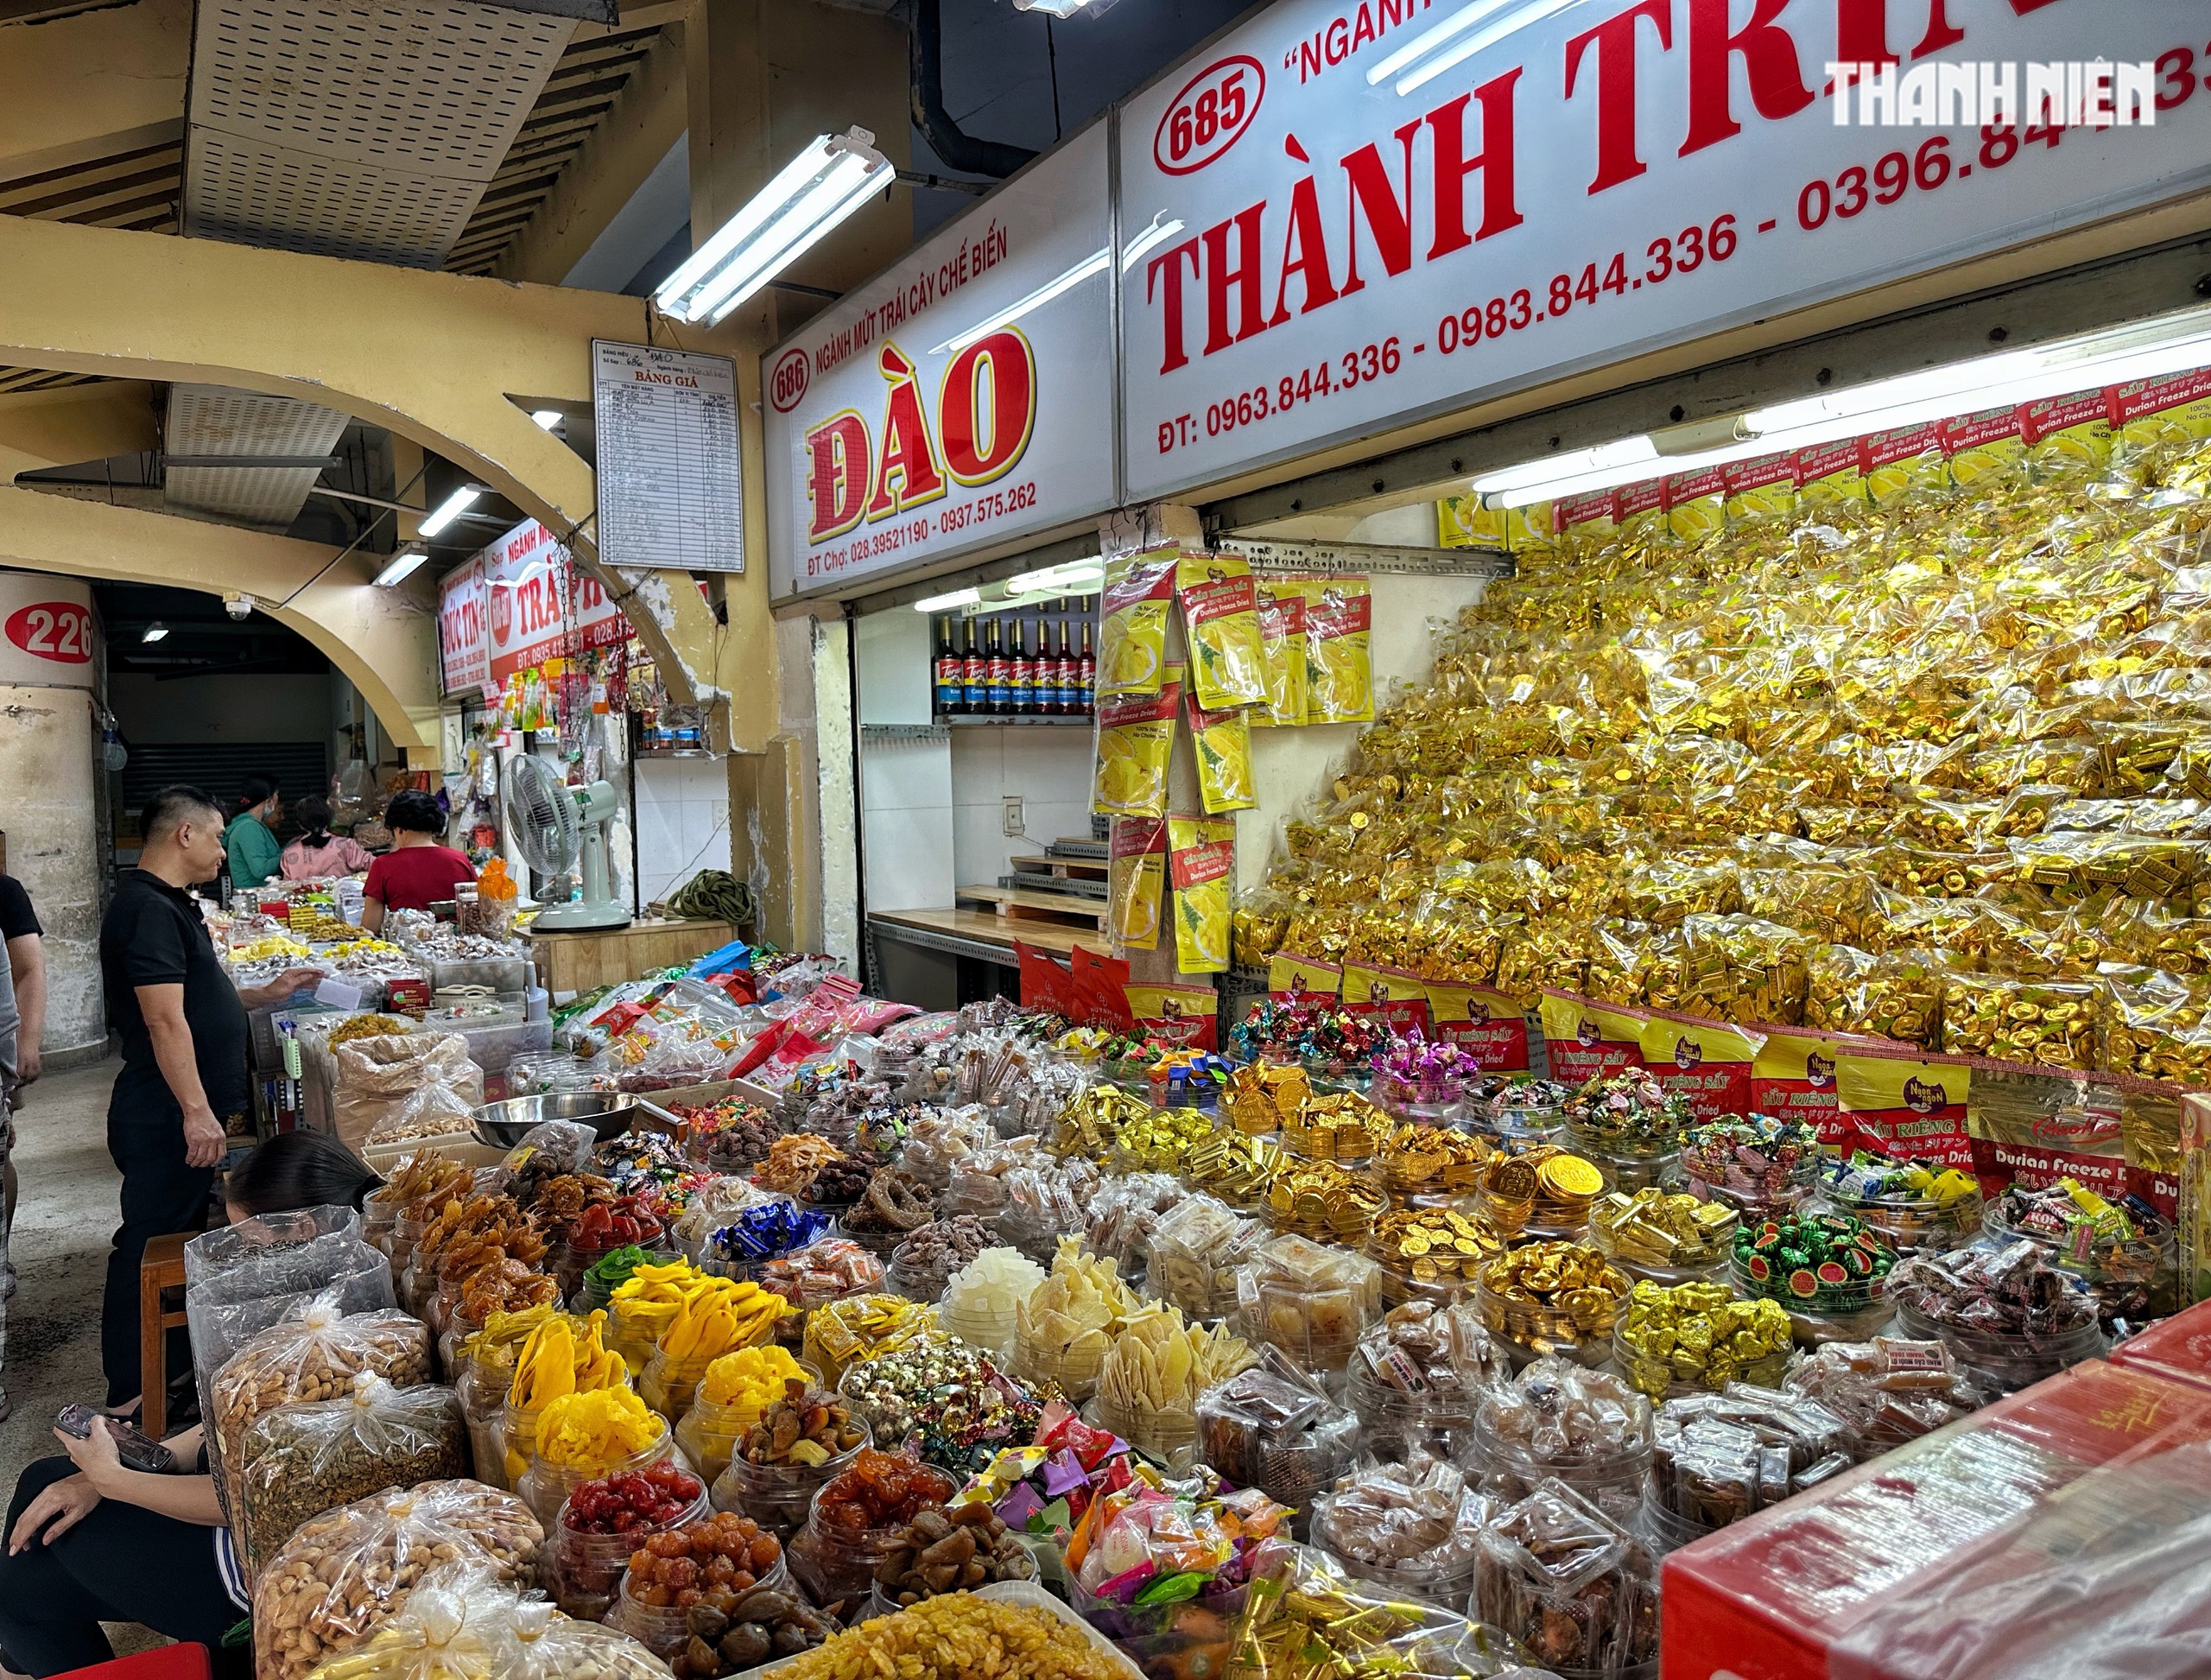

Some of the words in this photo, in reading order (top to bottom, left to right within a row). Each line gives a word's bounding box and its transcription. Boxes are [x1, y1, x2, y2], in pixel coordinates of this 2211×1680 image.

[1169, 69, 1245, 162] 685
[1148, 67, 1524, 376] THÀNH
[1564, 0, 2064, 196] TR
[815, 333, 851, 376] NGÀNH
[854, 309, 876, 352] MỨT
[879, 288, 905, 338] TRÁI
[909, 271, 934, 316] CÂY
[939, 238, 967, 296] CHẾ
[972, 219, 1008, 279] BIẾN
[1158, 412, 1198, 454] ĐT:
[1207, 336, 1400, 436] 0963.844.336
[1439, 213, 1736, 355] 0983.844.336
[635, 370, 671, 385] BẢNG
[675, 376, 699, 389] GIÁ
[777, 360, 804, 403] 686
[2125, 400, 2155, 416] Durian
[2158, 389, 2189, 405] Freeze
[2189, 403, 2211, 413] 100%
[2037, 416, 2062, 434] Durian
[2063, 409, 2094, 423] Freeze
[805, 324, 1036, 545] ĐÀO
[1953, 433, 1979, 448] Durian
[1980, 426, 2009, 440] Freeze
[1872, 450, 1894, 465] Durian
[1896, 443, 1921, 459] Freeze
[1752, 472, 1776, 484] Freeze
[1802, 466, 1823, 480] Durian
[1824, 459, 1846, 473] Freeze
[1672, 490, 1689, 503] Durian
[1690, 485, 1710, 498] Freeze
[808, 557, 821, 576] ĐT
[824, 548, 849, 572] Chợ:
[850, 523, 928, 562] 028.39521190
[941, 482, 1036, 534] 0937.575.262
[508, 529, 536, 565] NGÀNH
[1200, 605, 1219, 617] Durian
[1220, 602, 1237, 612] Freeze
[1237, 599, 1250, 609] Dried
[27, 609, 91, 656] 226
[1119, 712, 1139, 721] Freeze
[1139, 708, 1156, 717] Dried
[1485, 1054, 1504, 1063] Dried
[1565, 1050, 1601, 1065] RIÊNG
[1604, 1049, 1628, 1065] SẤY
[1663, 1072, 1701, 1089] RIÊNG
[1704, 1070, 1730, 1089] SẤY
[1910, 1082, 1930, 1098] Ngon
[1789, 1090, 1837, 1106] RIÊNG
[1922, 1091, 1943, 1105] ngoN
[1697, 1104, 1720, 1116] Dried
[1897, 1117, 1956, 1138] RIÊNG
[1995, 1149, 2048, 1170] Durian
[2053, 1157, 2113, 1179] Freeze
[2154, 1180, 2178, 1196] Du
